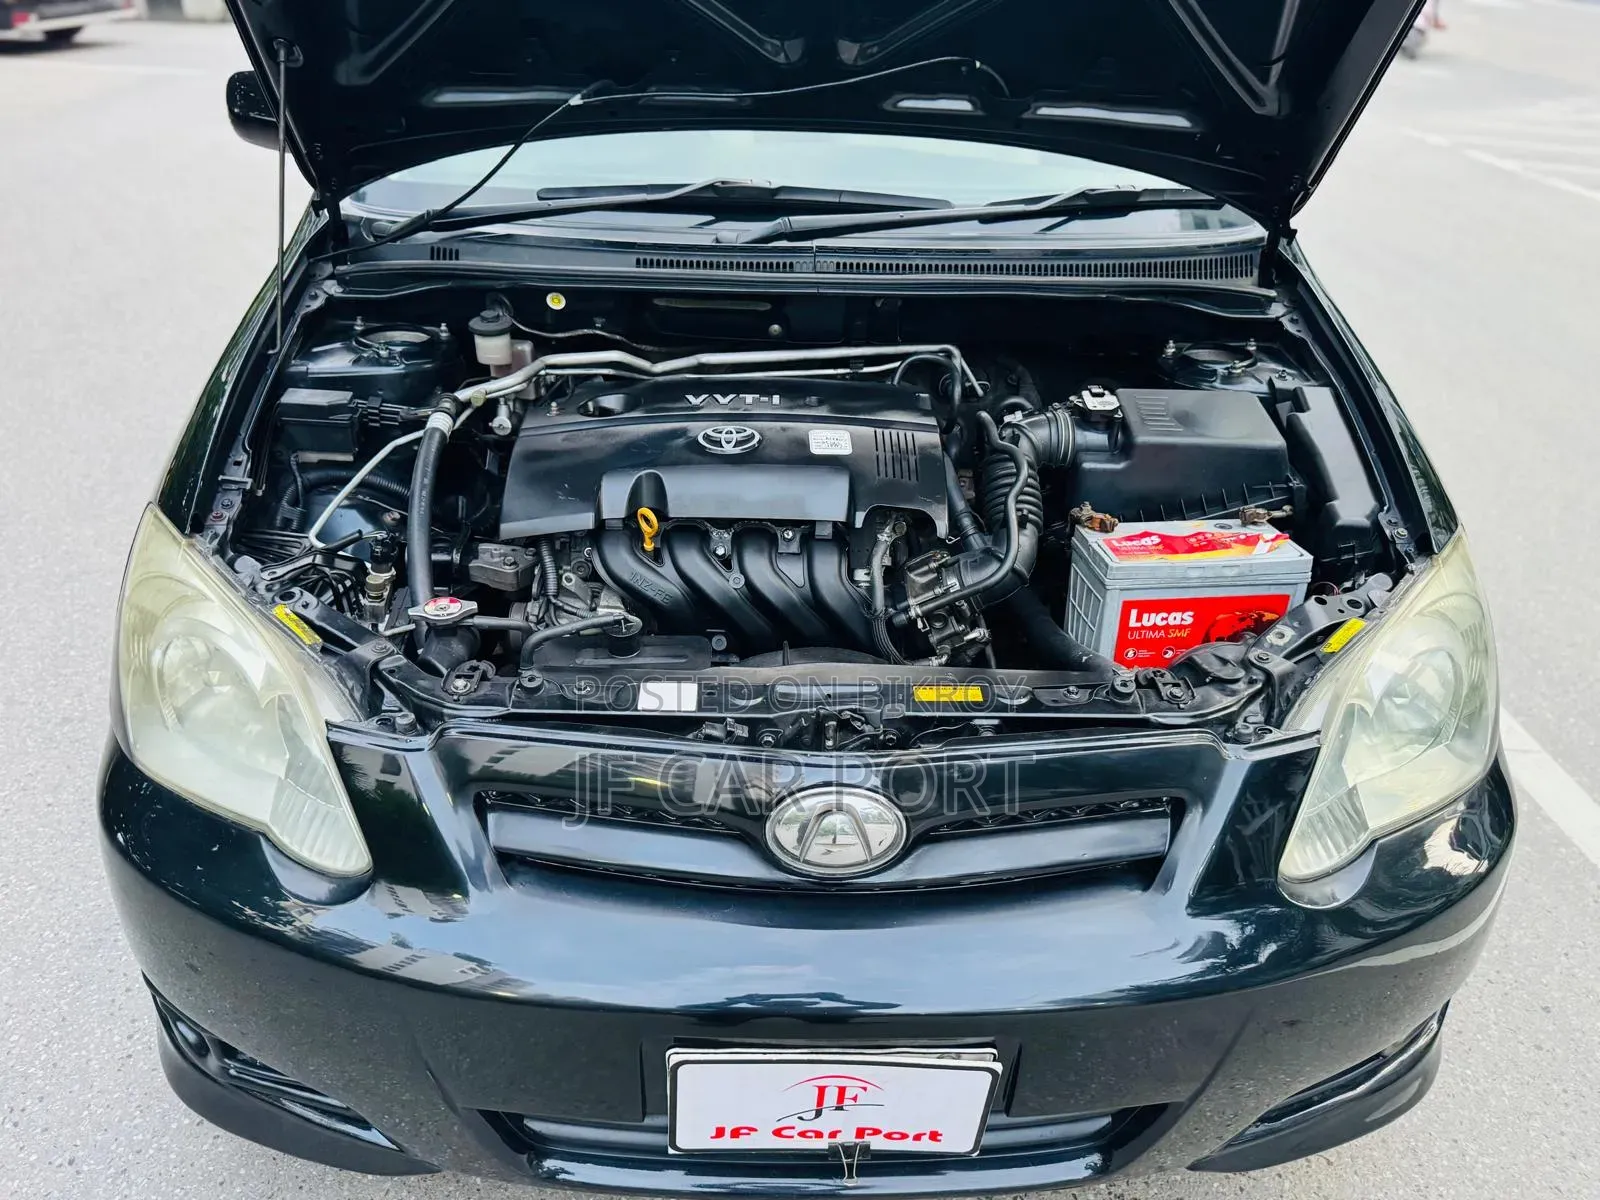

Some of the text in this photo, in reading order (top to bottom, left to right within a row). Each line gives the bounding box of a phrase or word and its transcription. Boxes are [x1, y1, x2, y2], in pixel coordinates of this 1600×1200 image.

[1128, 608, 1195, 628] Lucas
[1127, 628, 1191, 640] ULTIMA SMF
[797, 1085, 868, 1122] JF
[710, 1126, 943, 1143] JF Car Port
